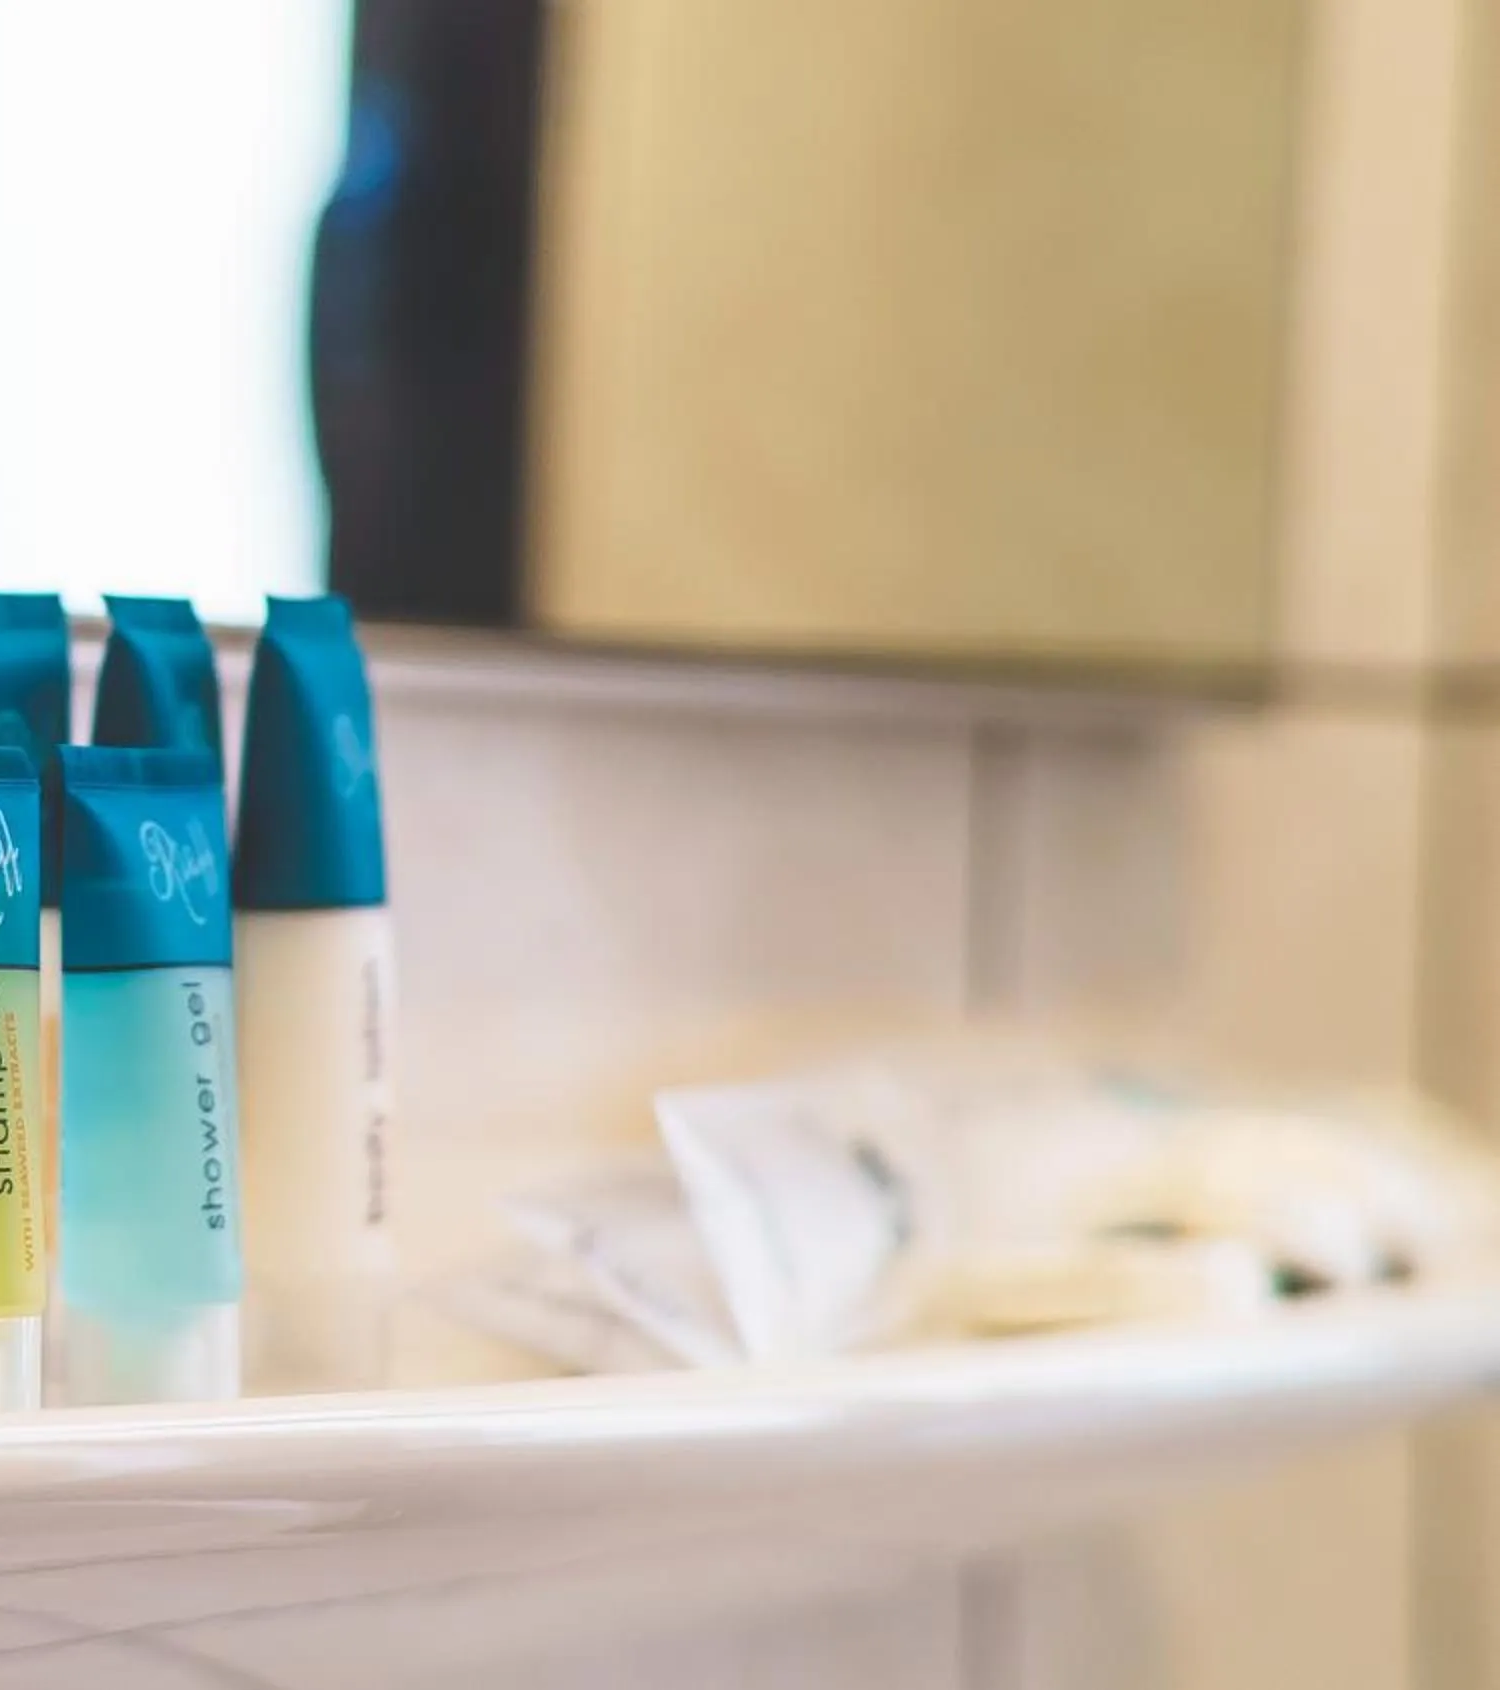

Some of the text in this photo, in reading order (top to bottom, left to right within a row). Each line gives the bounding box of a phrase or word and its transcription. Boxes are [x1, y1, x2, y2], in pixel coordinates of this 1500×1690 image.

[180, 982, 212, 1046] gel
[5, 1011, 34, 1272] WITH SEAWEED EXTRACTS
[196, 1074, 226, 1229] shower
